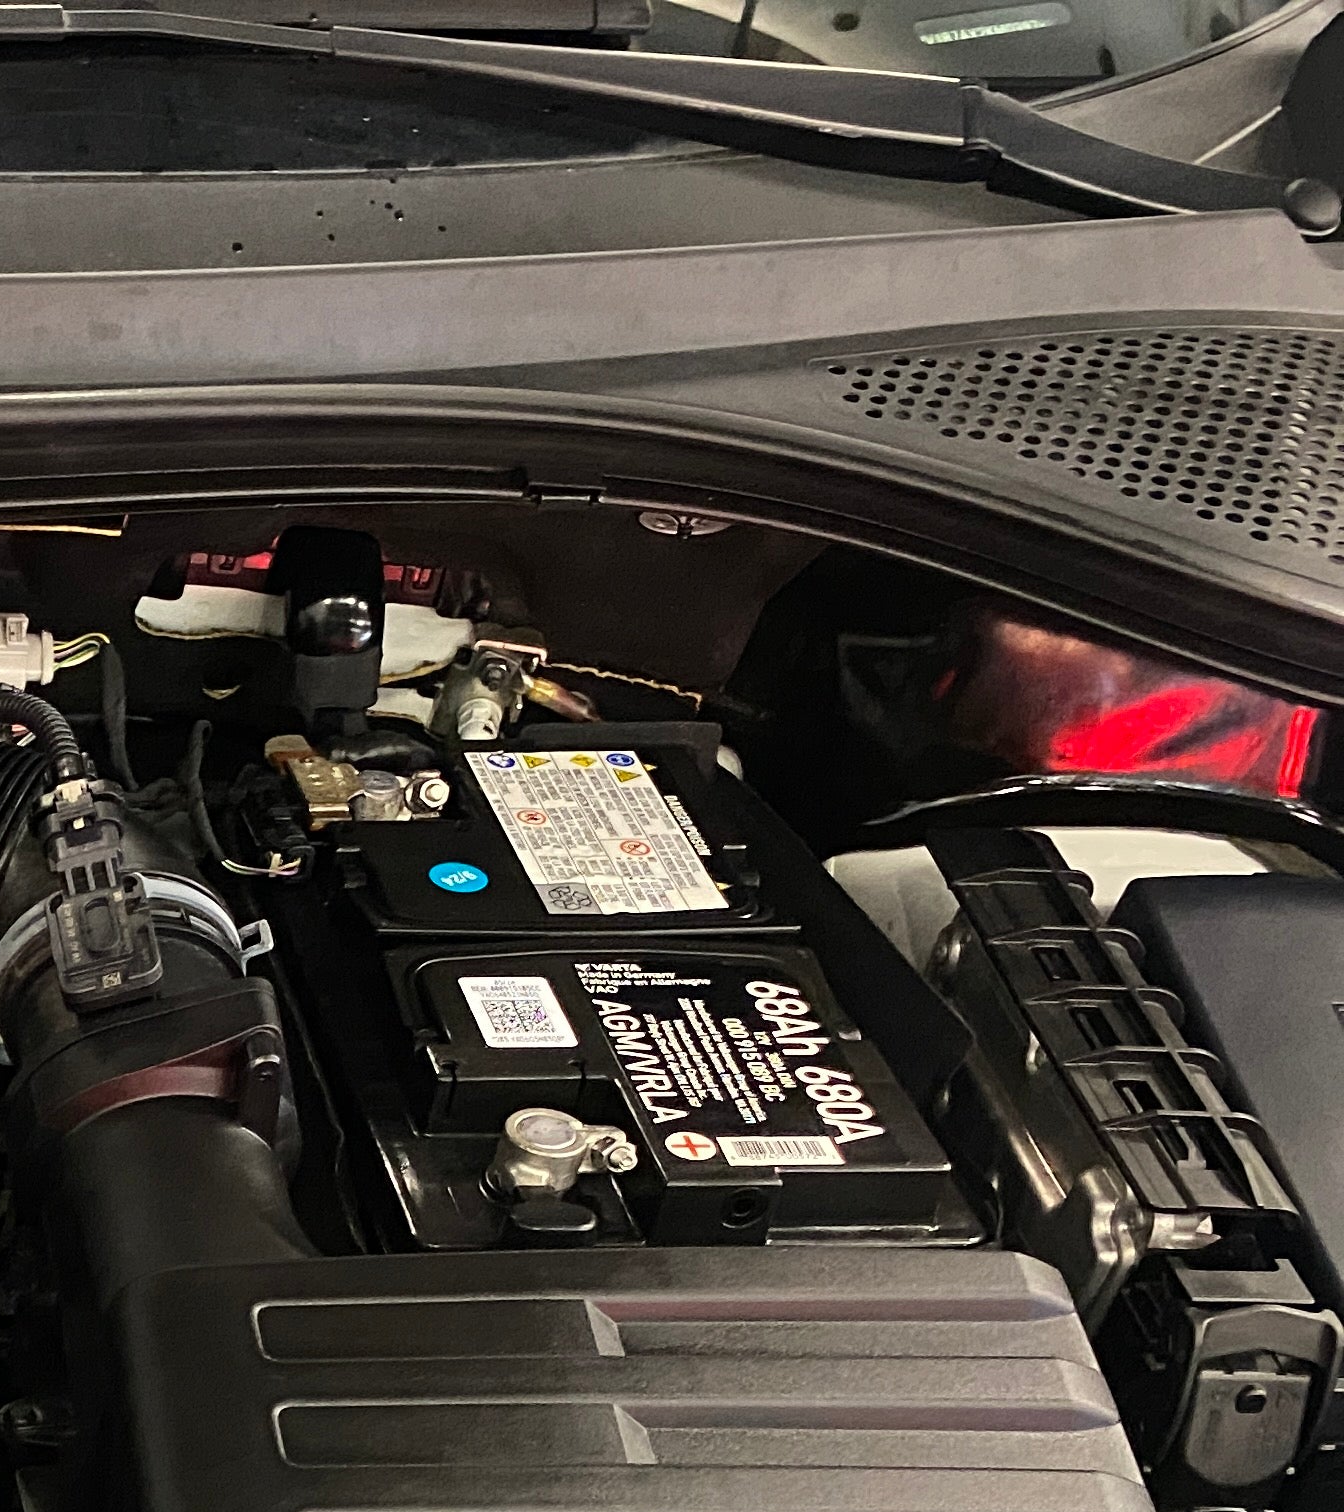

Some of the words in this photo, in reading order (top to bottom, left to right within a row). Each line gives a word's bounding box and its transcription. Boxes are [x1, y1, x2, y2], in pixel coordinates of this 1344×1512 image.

[591, 963, 642, 972] VARTA
[722, 1018, 749, 1039] 000
[759, 1084, 786, 1101] BC
[745, 981, 831, 1055] 68Ah
[795, 1066, 885, 1144] 680A
